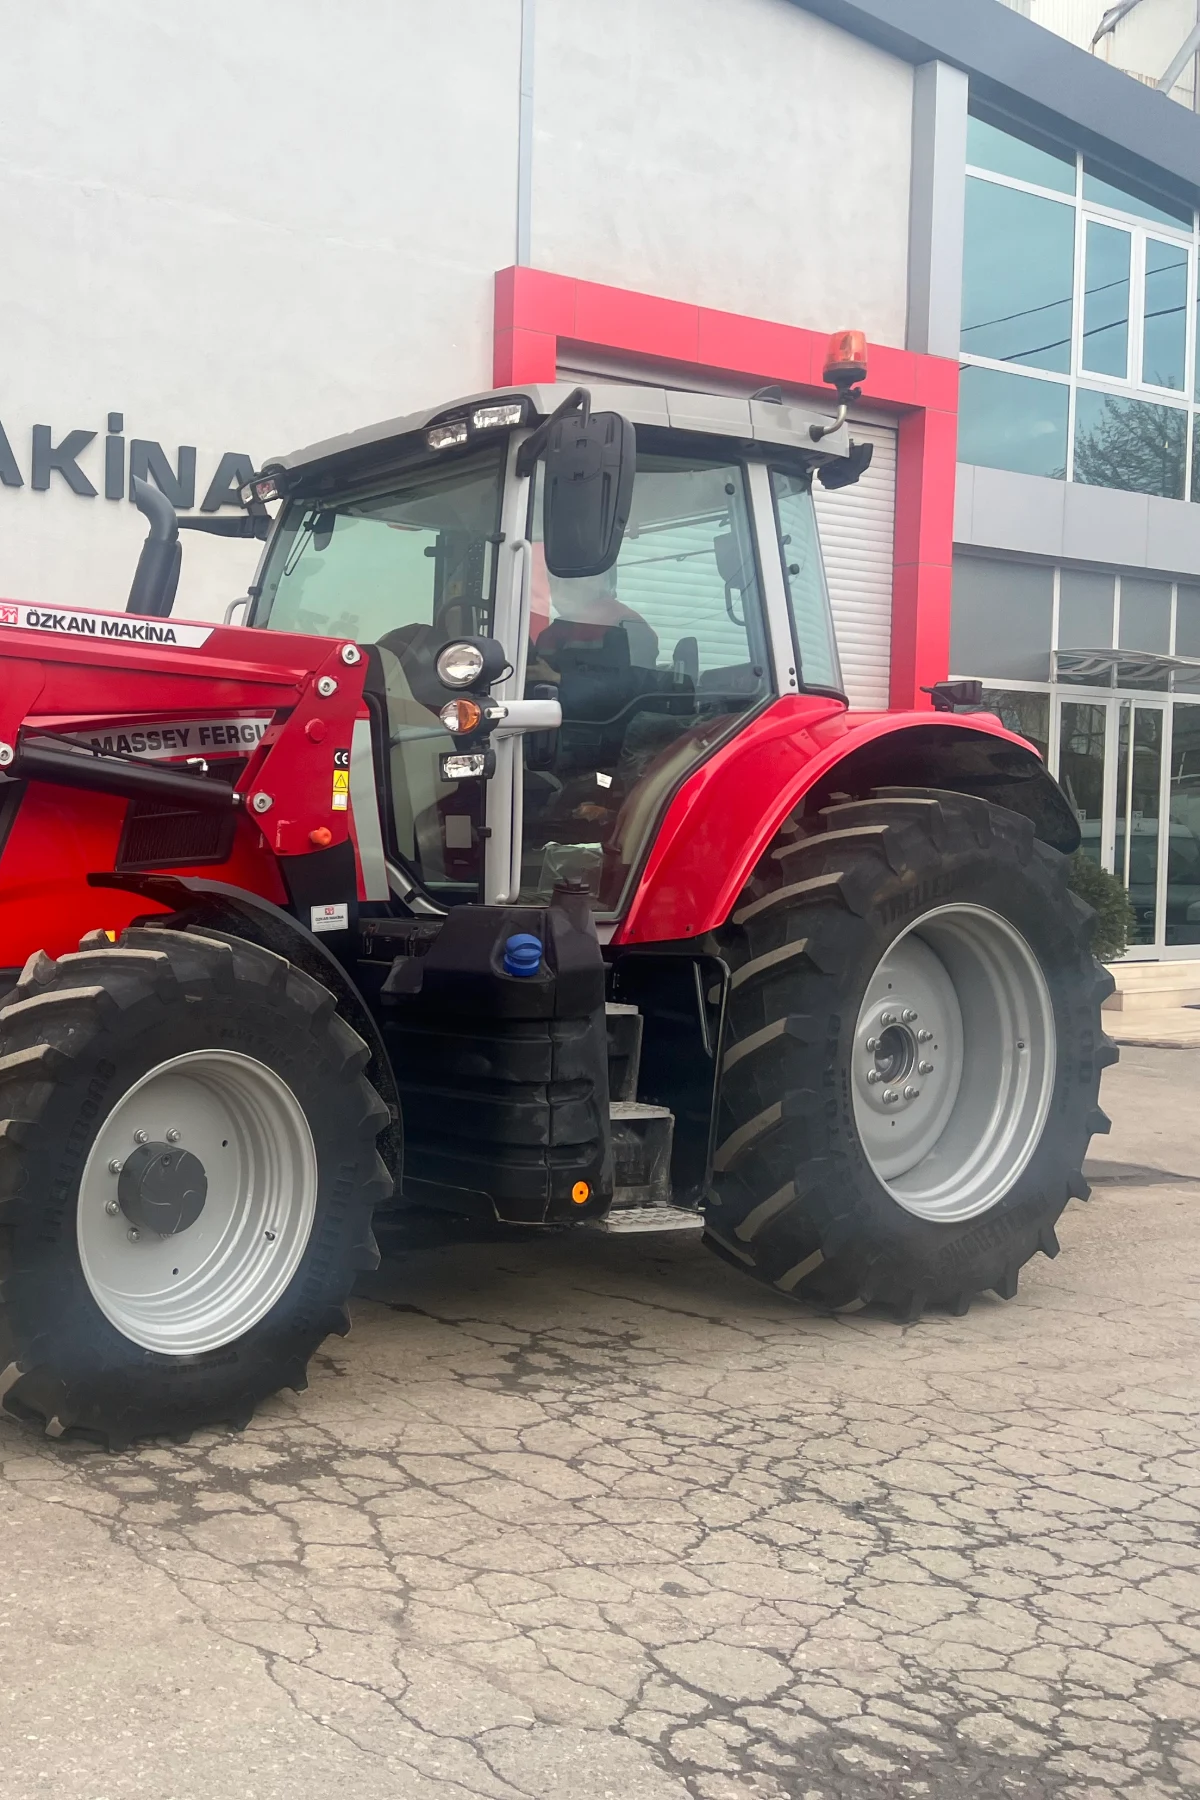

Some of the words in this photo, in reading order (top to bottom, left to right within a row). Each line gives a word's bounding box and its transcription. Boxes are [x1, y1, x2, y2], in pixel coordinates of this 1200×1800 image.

[26, 608, 97, 635] ÖZKAN
[100, 620, 178, 644] MAKİNA
[91, 728, 190, 757] MASSEY
